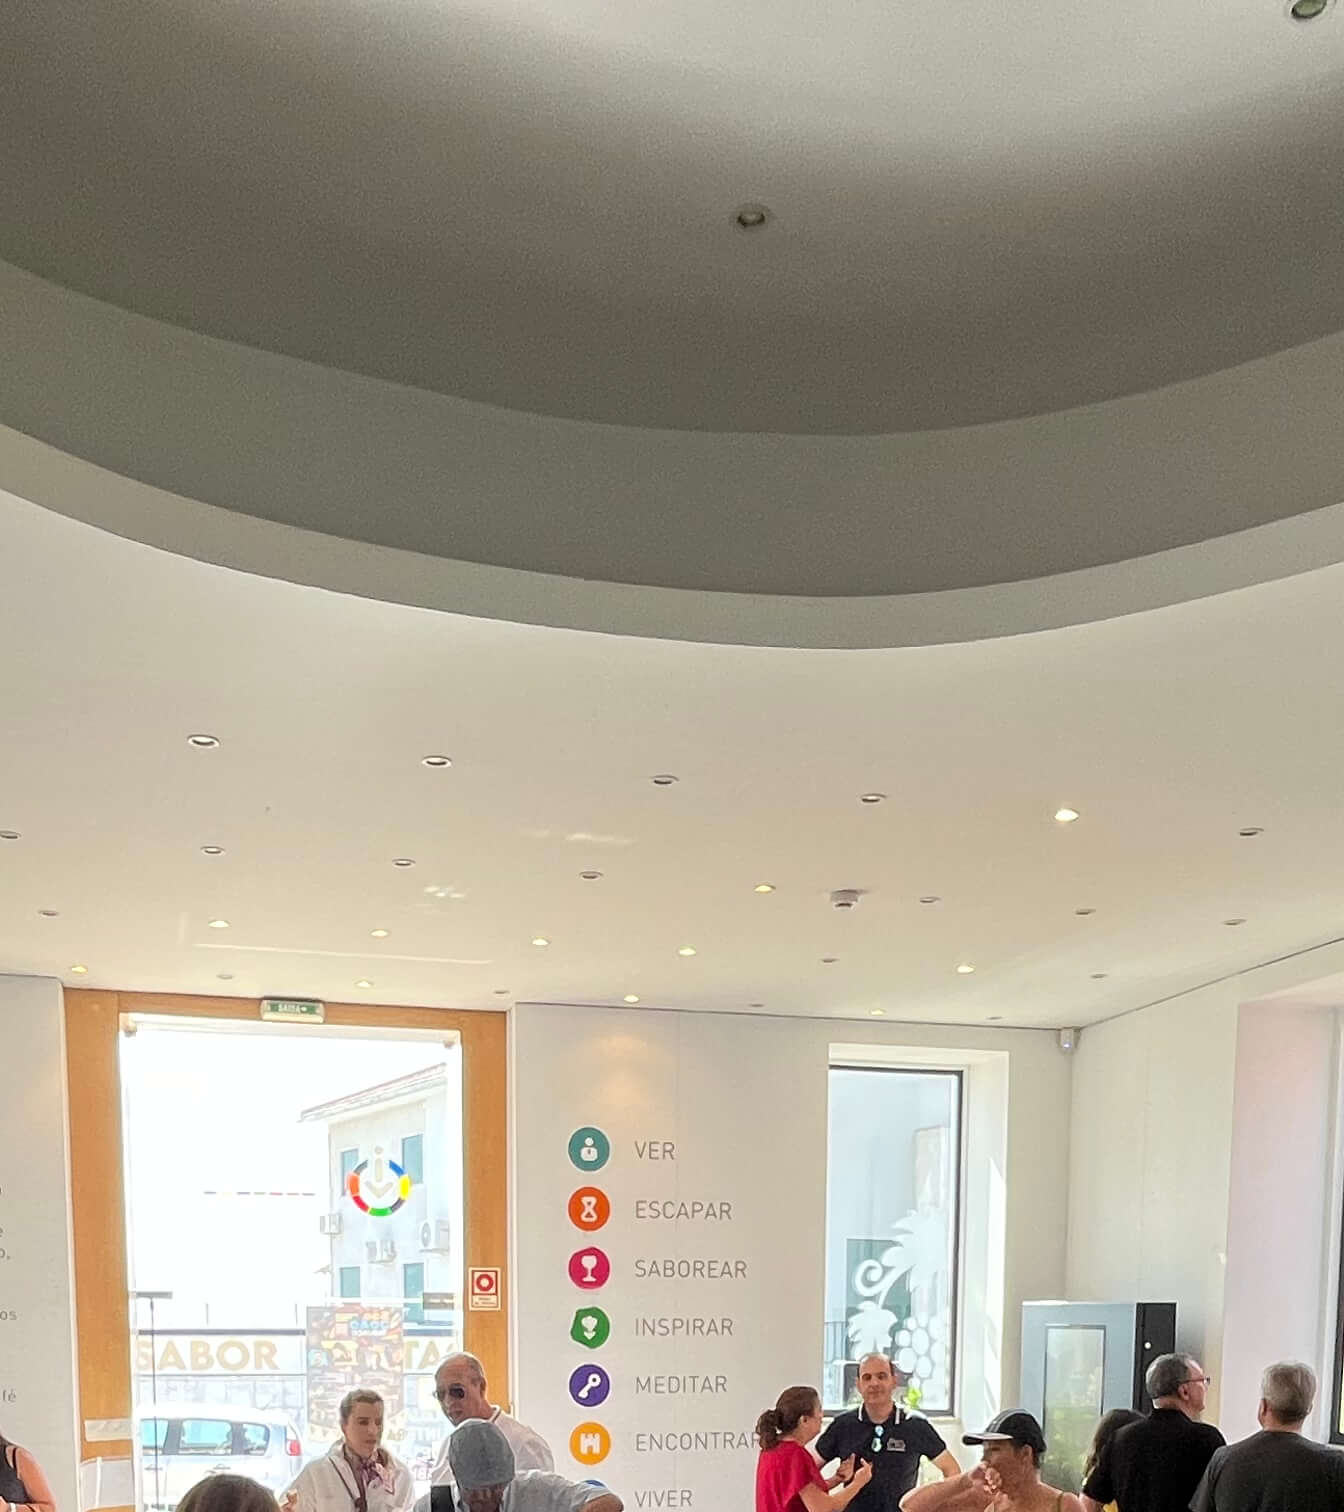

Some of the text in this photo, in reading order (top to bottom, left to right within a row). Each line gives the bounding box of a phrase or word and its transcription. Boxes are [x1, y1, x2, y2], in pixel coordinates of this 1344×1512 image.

[635, 1141, 674, 1160] VER
[635, 1201, 732, 1220] ESCAPAR
[635, 1260, 746, 1278] SABOREAR
[635, 1318, 733, 1336] INSPIRAR
[636, 1376, 727, 1393] MEDITAR
[635, 1490, 692, 1507] VIVER
